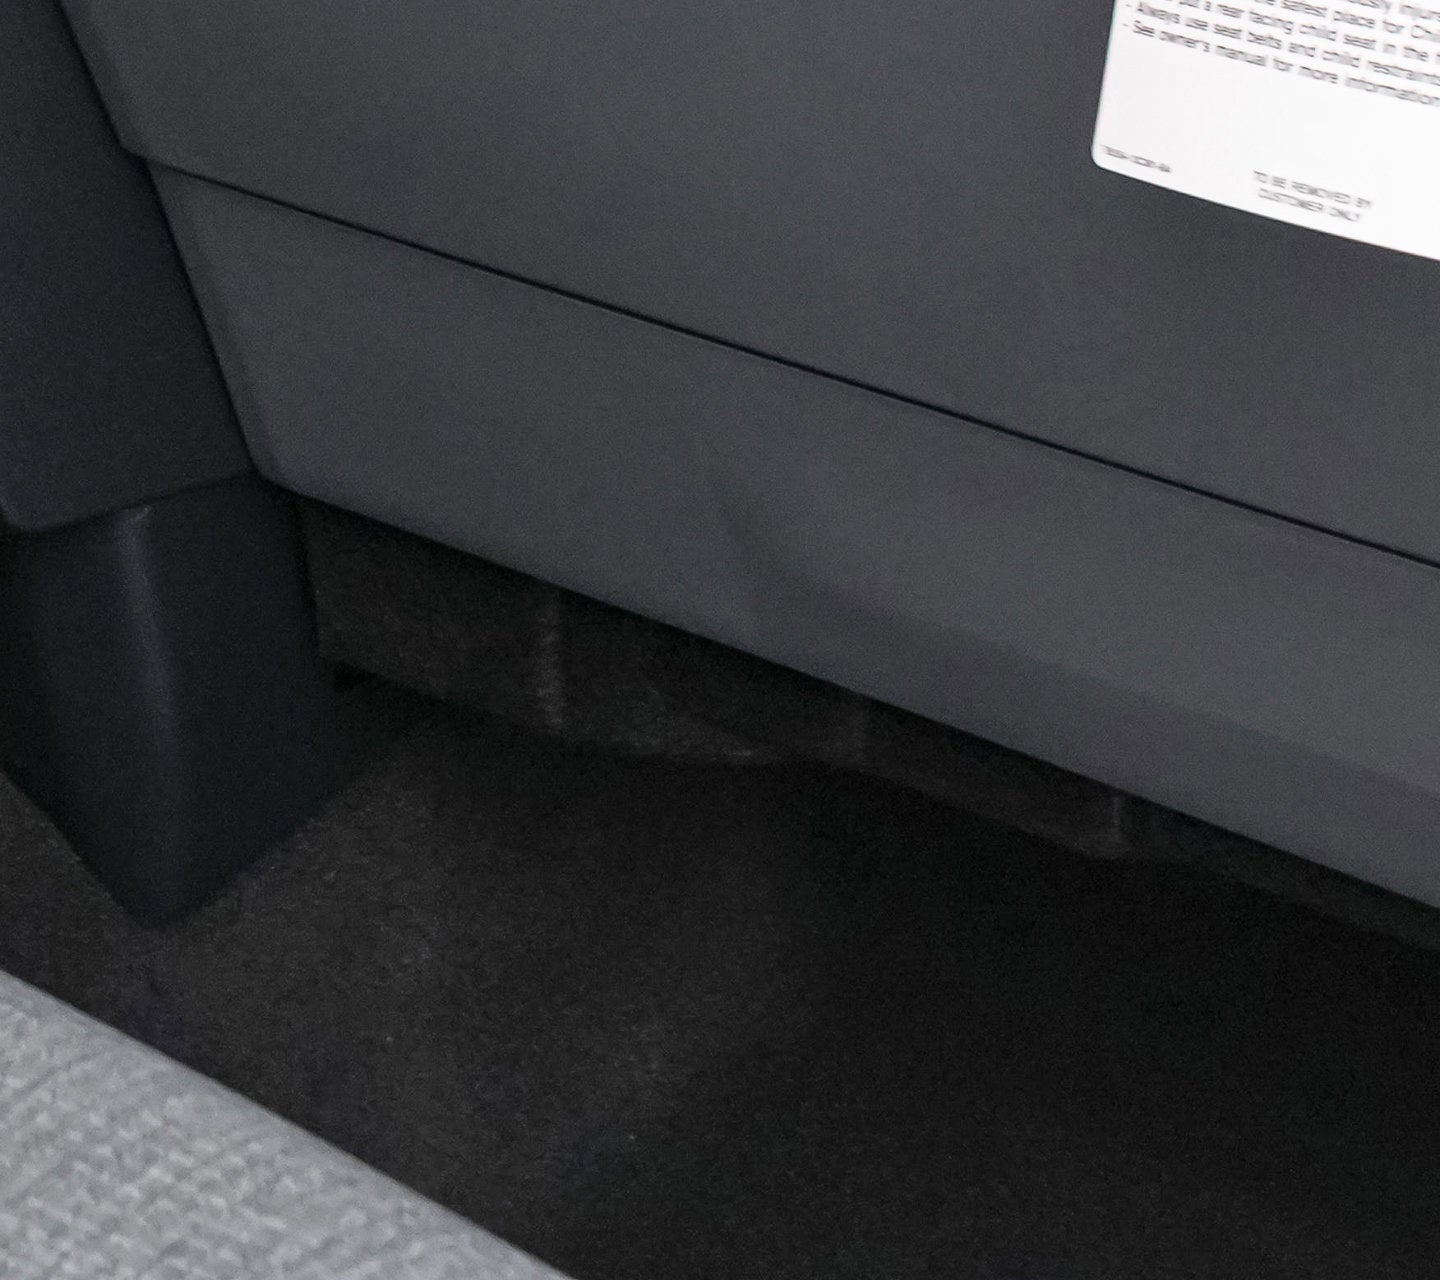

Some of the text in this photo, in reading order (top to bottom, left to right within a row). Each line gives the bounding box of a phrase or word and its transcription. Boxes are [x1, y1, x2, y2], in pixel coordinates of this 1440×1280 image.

[1136, 2, 1181, 24] Always
[1184, 18, 1209, 31] use
[1213, 24, 1242, 39] seat
[1246, 31, 1282, 50] belts
[1288, 42, 1316, 58] and
[1322, 50, 1361, 68] child
[1204, 1, 1212, 11] a
[1217, 4, 1245, 18] rear
[1249, 9, 1294, 35] facing
[1299, 24, 1337, 41] child
[1343, 34, 1377, 50] seat
[1382, 43, 1397, 54] in
[1403, 46, 1429, 62] the
[1281, 0, 1328, 18] safest
[1333, 10, 1376, 29] place
[1382, 22, 1405, 34] for
[1133, 20, 1155, 37] See
[1159, 31, 1210, 52] owner's
[1216, 45, 1267, 67] manual
[1273, 57, 1294, 72] for
[1299, 66, 1338, 84] more
[1345, 77, 1440, 106] information
[1258, 188, 1360, 222] CUSTOMER ONLY
[1291, 181, 1351, 204] REMOVED
